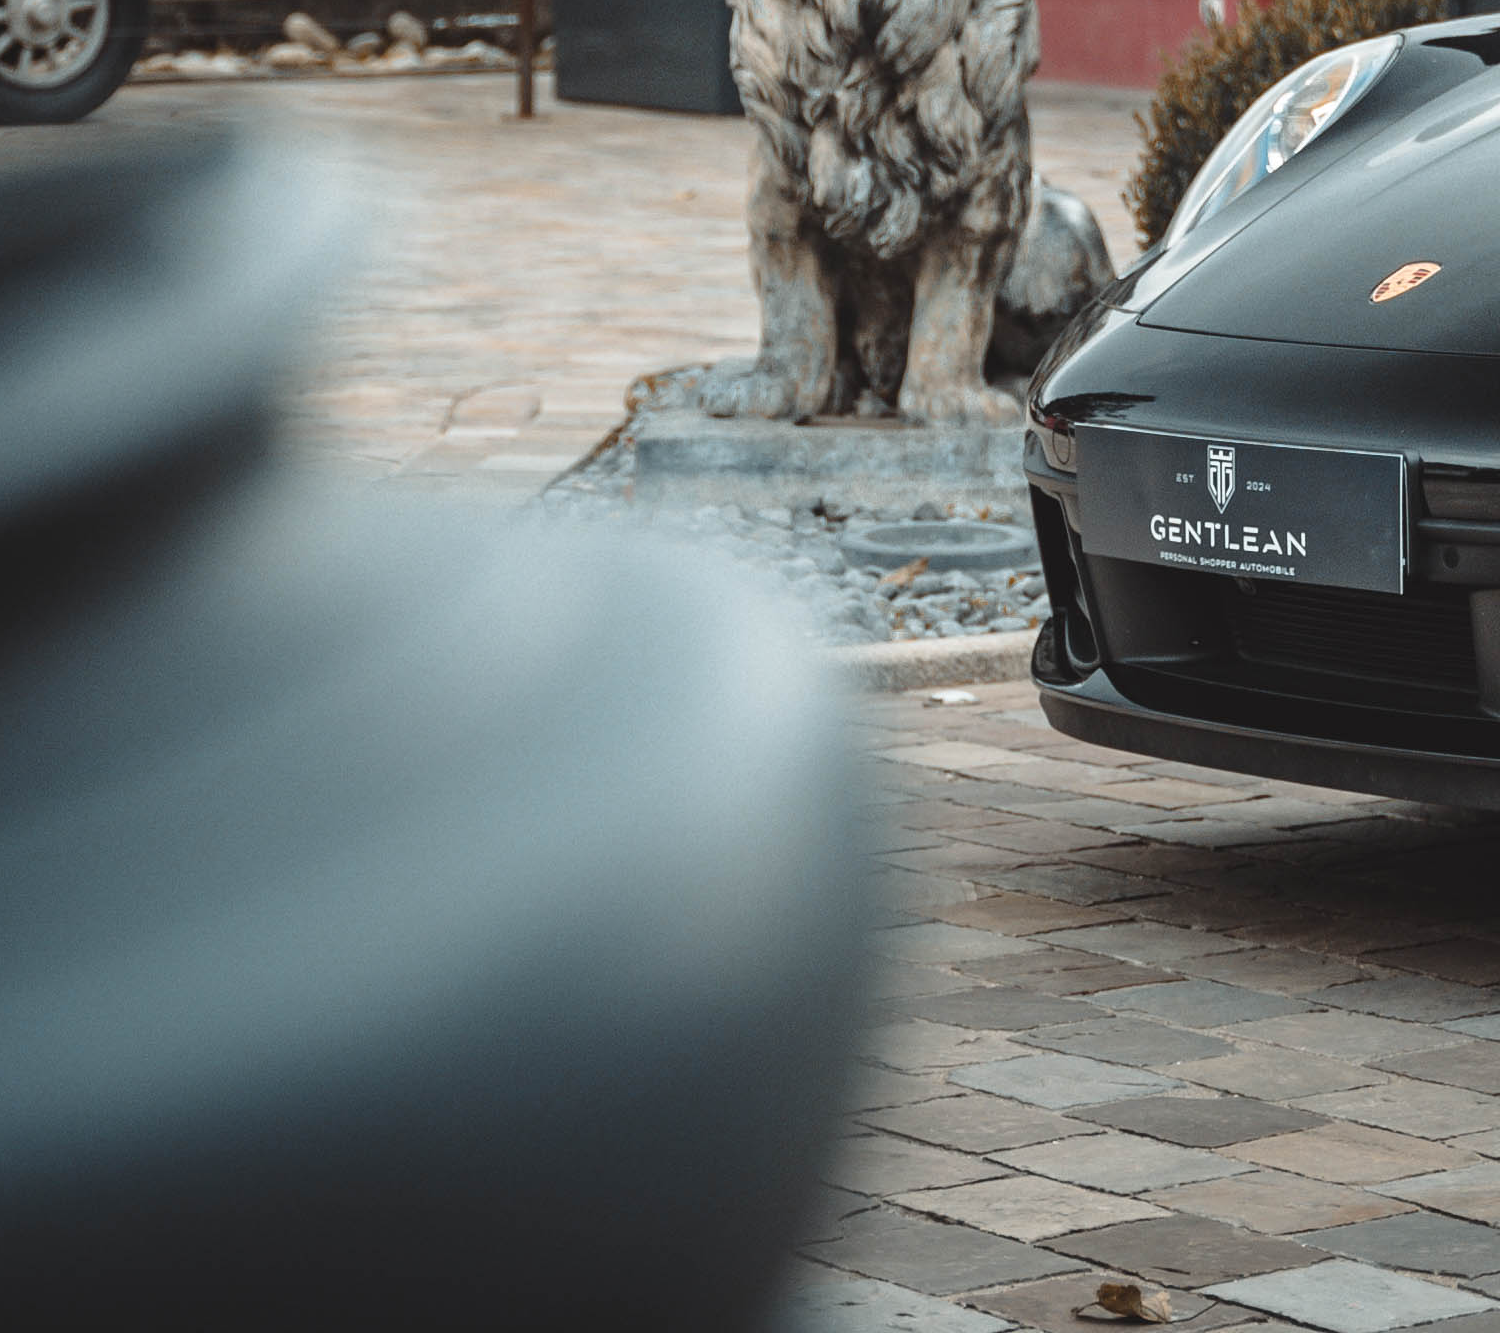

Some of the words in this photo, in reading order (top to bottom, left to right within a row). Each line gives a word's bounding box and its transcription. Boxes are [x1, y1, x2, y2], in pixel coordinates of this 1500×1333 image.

[1246, 481, 1271, 491] 2024
[1150, 514, 1306, 557] GENTLEAN
[1160, 551, 1198, 565] PERSONAL
[1200, 556, 1237, 569] SHOPPER
[1239, 562, 1295, 576] AUTOMOBILE
